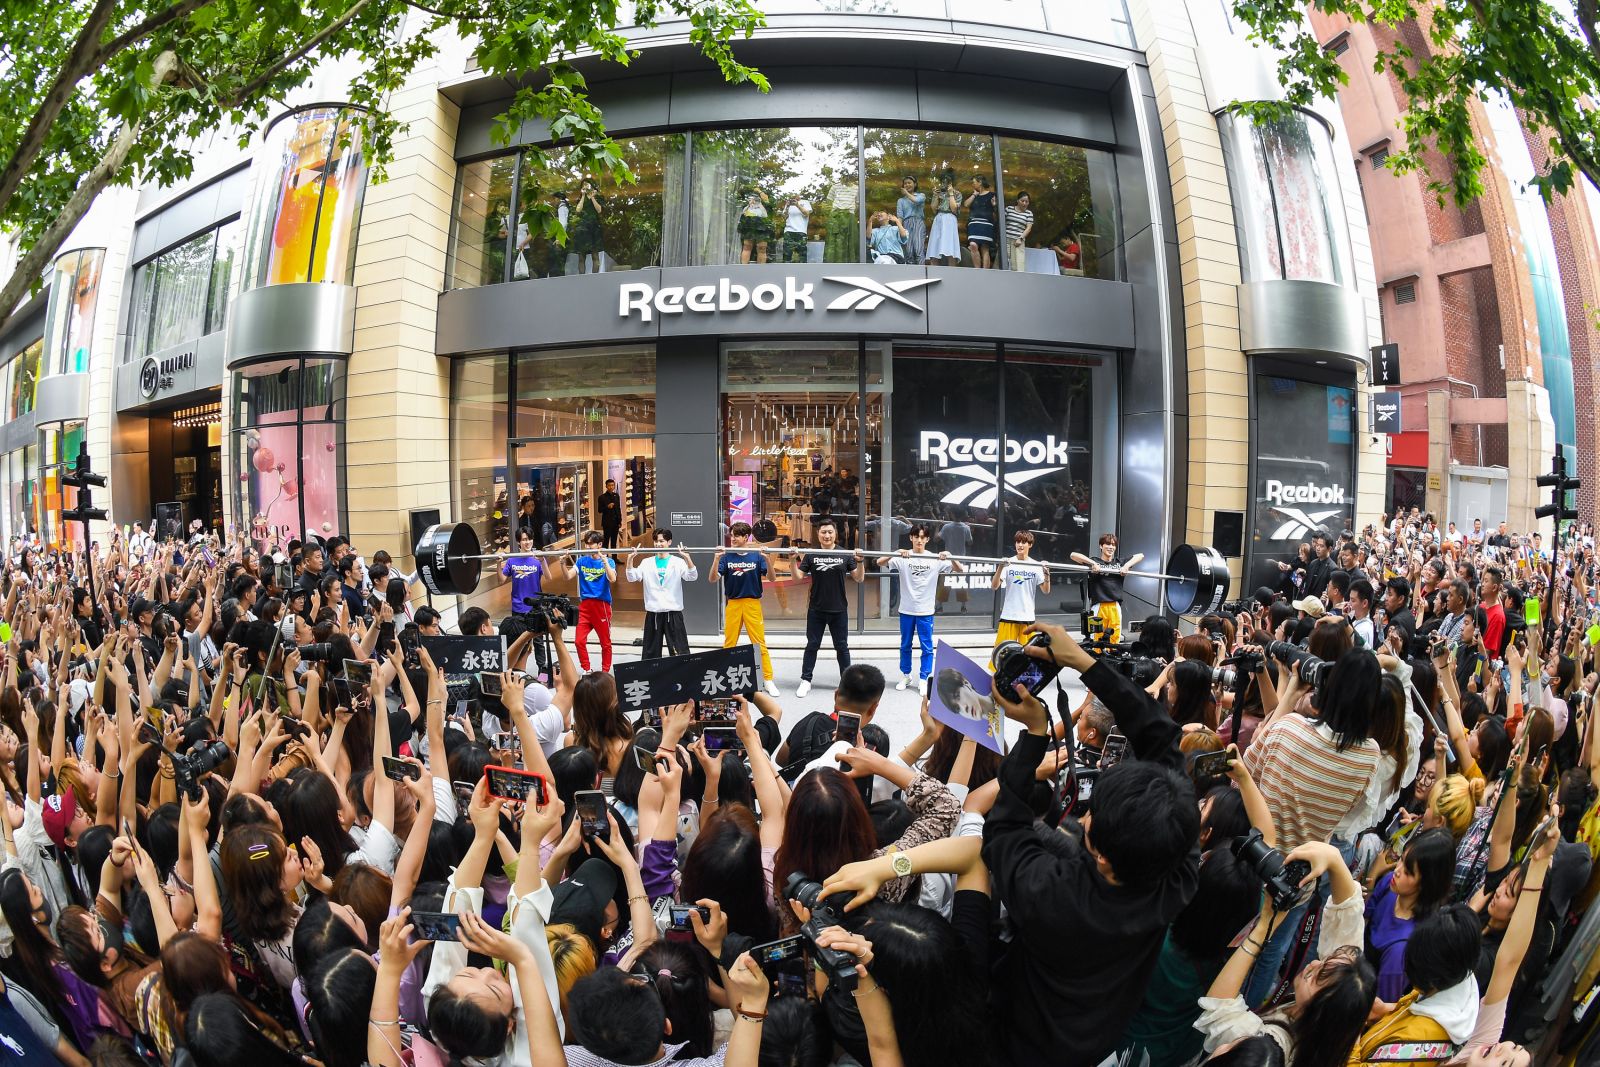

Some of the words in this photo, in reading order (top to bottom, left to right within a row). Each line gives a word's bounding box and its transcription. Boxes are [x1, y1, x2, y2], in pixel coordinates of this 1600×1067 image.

[618, 276, 814, 321] Reebok
[1376, 404, 1398, 412] Reebok
[920, 430, 1068, 467] Reebok
[1265, 479, 1344, 505] Reebok
[511, 564, 538, 572] Reebok
[727, 561, 757, 569] Reebok
[1008, 569, 1037, 578] Reebok
[462, 649, 499, 670] 永钦
[623, 679, 652, 707] 李
[701, 664, 753, 696] 永钦
